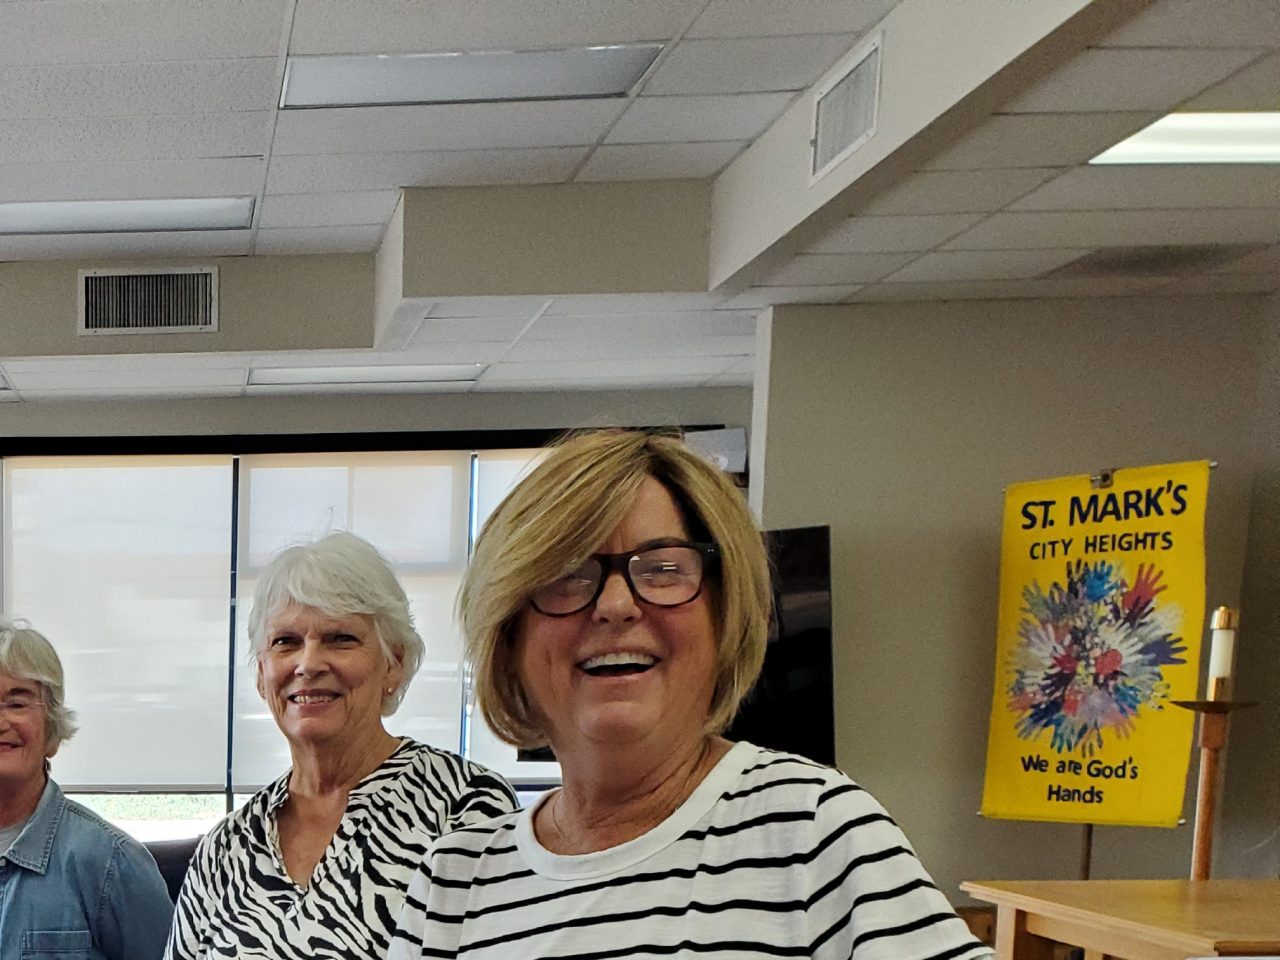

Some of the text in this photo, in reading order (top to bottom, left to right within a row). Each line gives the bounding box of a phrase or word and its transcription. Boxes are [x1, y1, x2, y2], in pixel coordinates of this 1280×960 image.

[1021, 480, 1187, 530] ST. MARK'S
[1029, 531, 1173, 560] CITY HEIGHTS
[1021, 754, 1138, 779] We are God's
[1047, 784, 1104, 804] Hands
